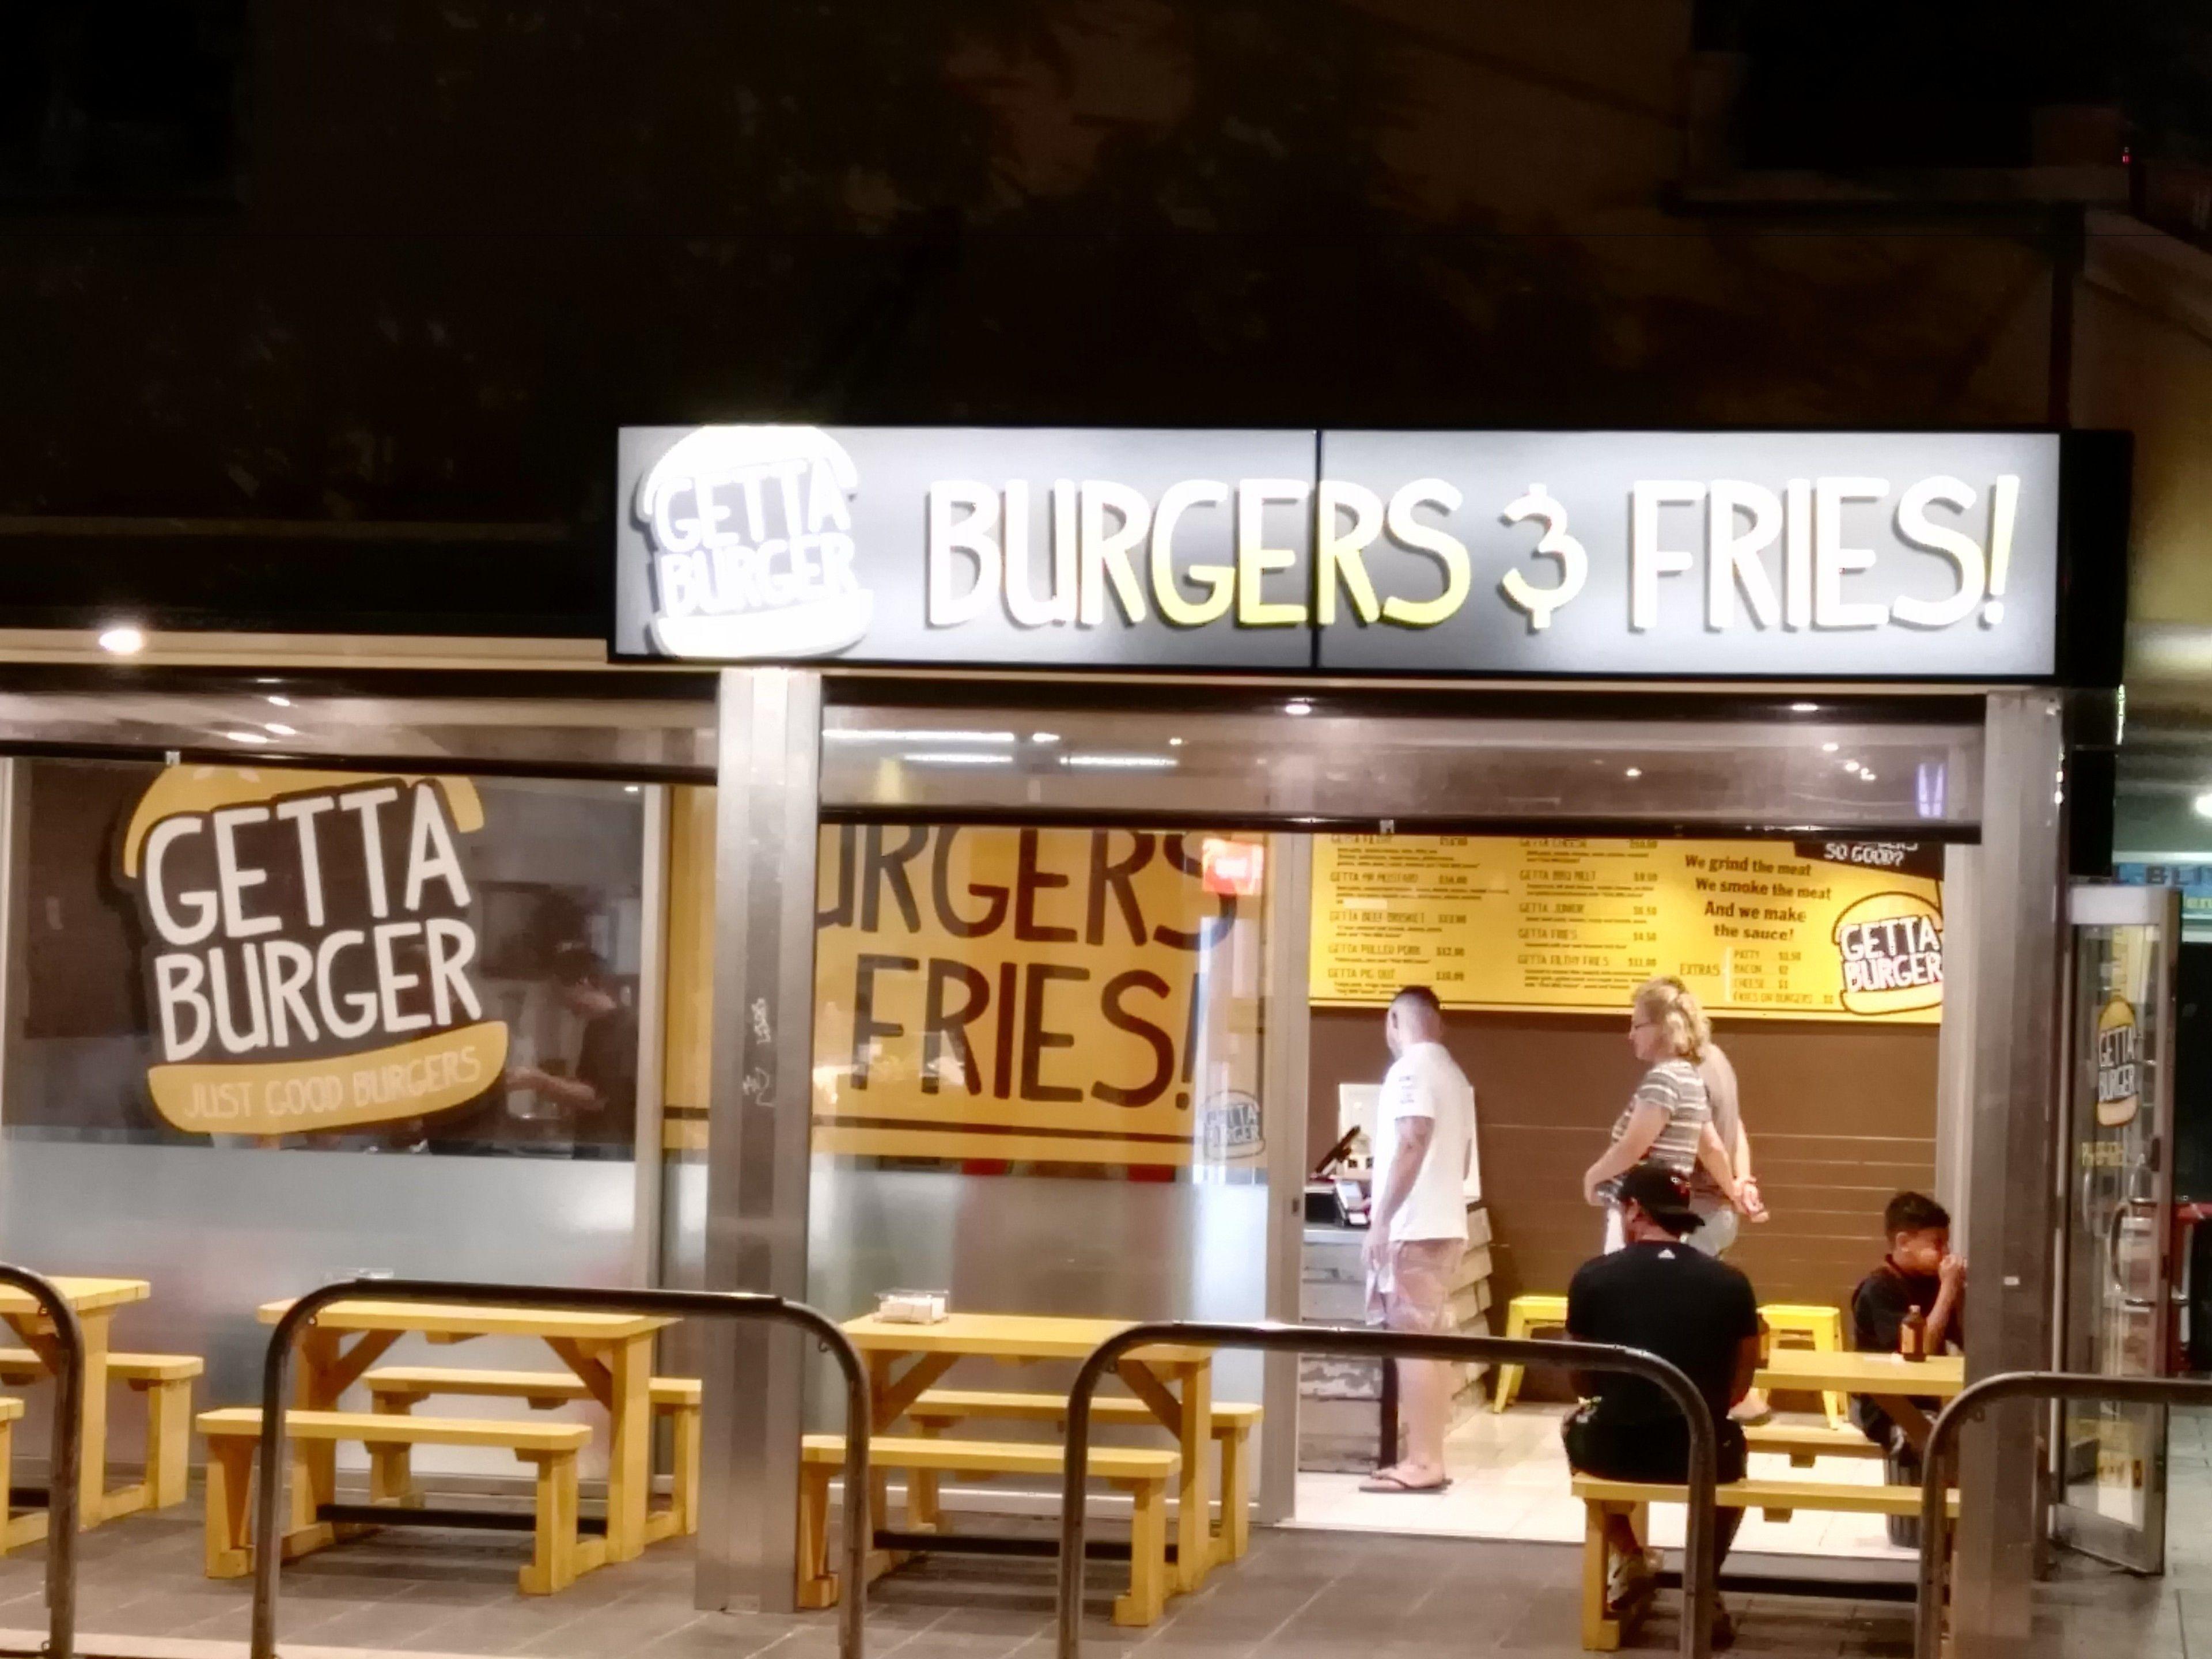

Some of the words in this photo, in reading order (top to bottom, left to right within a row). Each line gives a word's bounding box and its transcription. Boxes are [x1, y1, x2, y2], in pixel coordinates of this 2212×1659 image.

[654, 451, 851, 551] GETTA
[929, 478, 1471, 627] BURGERS
[1633, 474, 2020, 628] FRIES!
[661, 533, 862, 618] BURGER
[145, 782, 471, 946] GETTA
[1685, 854, 1705, 868] We
[1709, 857, 1749, 872] grind
[1753, 859, 1774, 873] the
[1777, 863, 1812, 877] meat
[1824, 843, 1848, 859] SO
[1851, 846, 1904, 866] GOOD?
[1695, 877, 1716, 891] We
[1720, 880, 1768, 896] smoke
[1772, 883, 1794, 897] the
[1797, 888, 1832, 901] meat
[1704, 900, 1734, 917] And
[1738, 907, 1760, 920] we
[1764, 907, 1806, 923] make
[1714, 923, 1738, 938] the
[1743, 928, 1794, 941] sauce!
[1840, 914, 1941, 962] GETTA
[154, 918, 482, 1062] BURGER
[1680, 963, 1721, 976] EXTRAS
[1843, 952, 1944, 993] BURGER
[849, 953, 1201, 1110] FRIES!
[184, 1082, 254, 1119] JUST
[264, 1074, 344, 1118] GOOD
[353, 1046, 482, 1108] BURGERS
